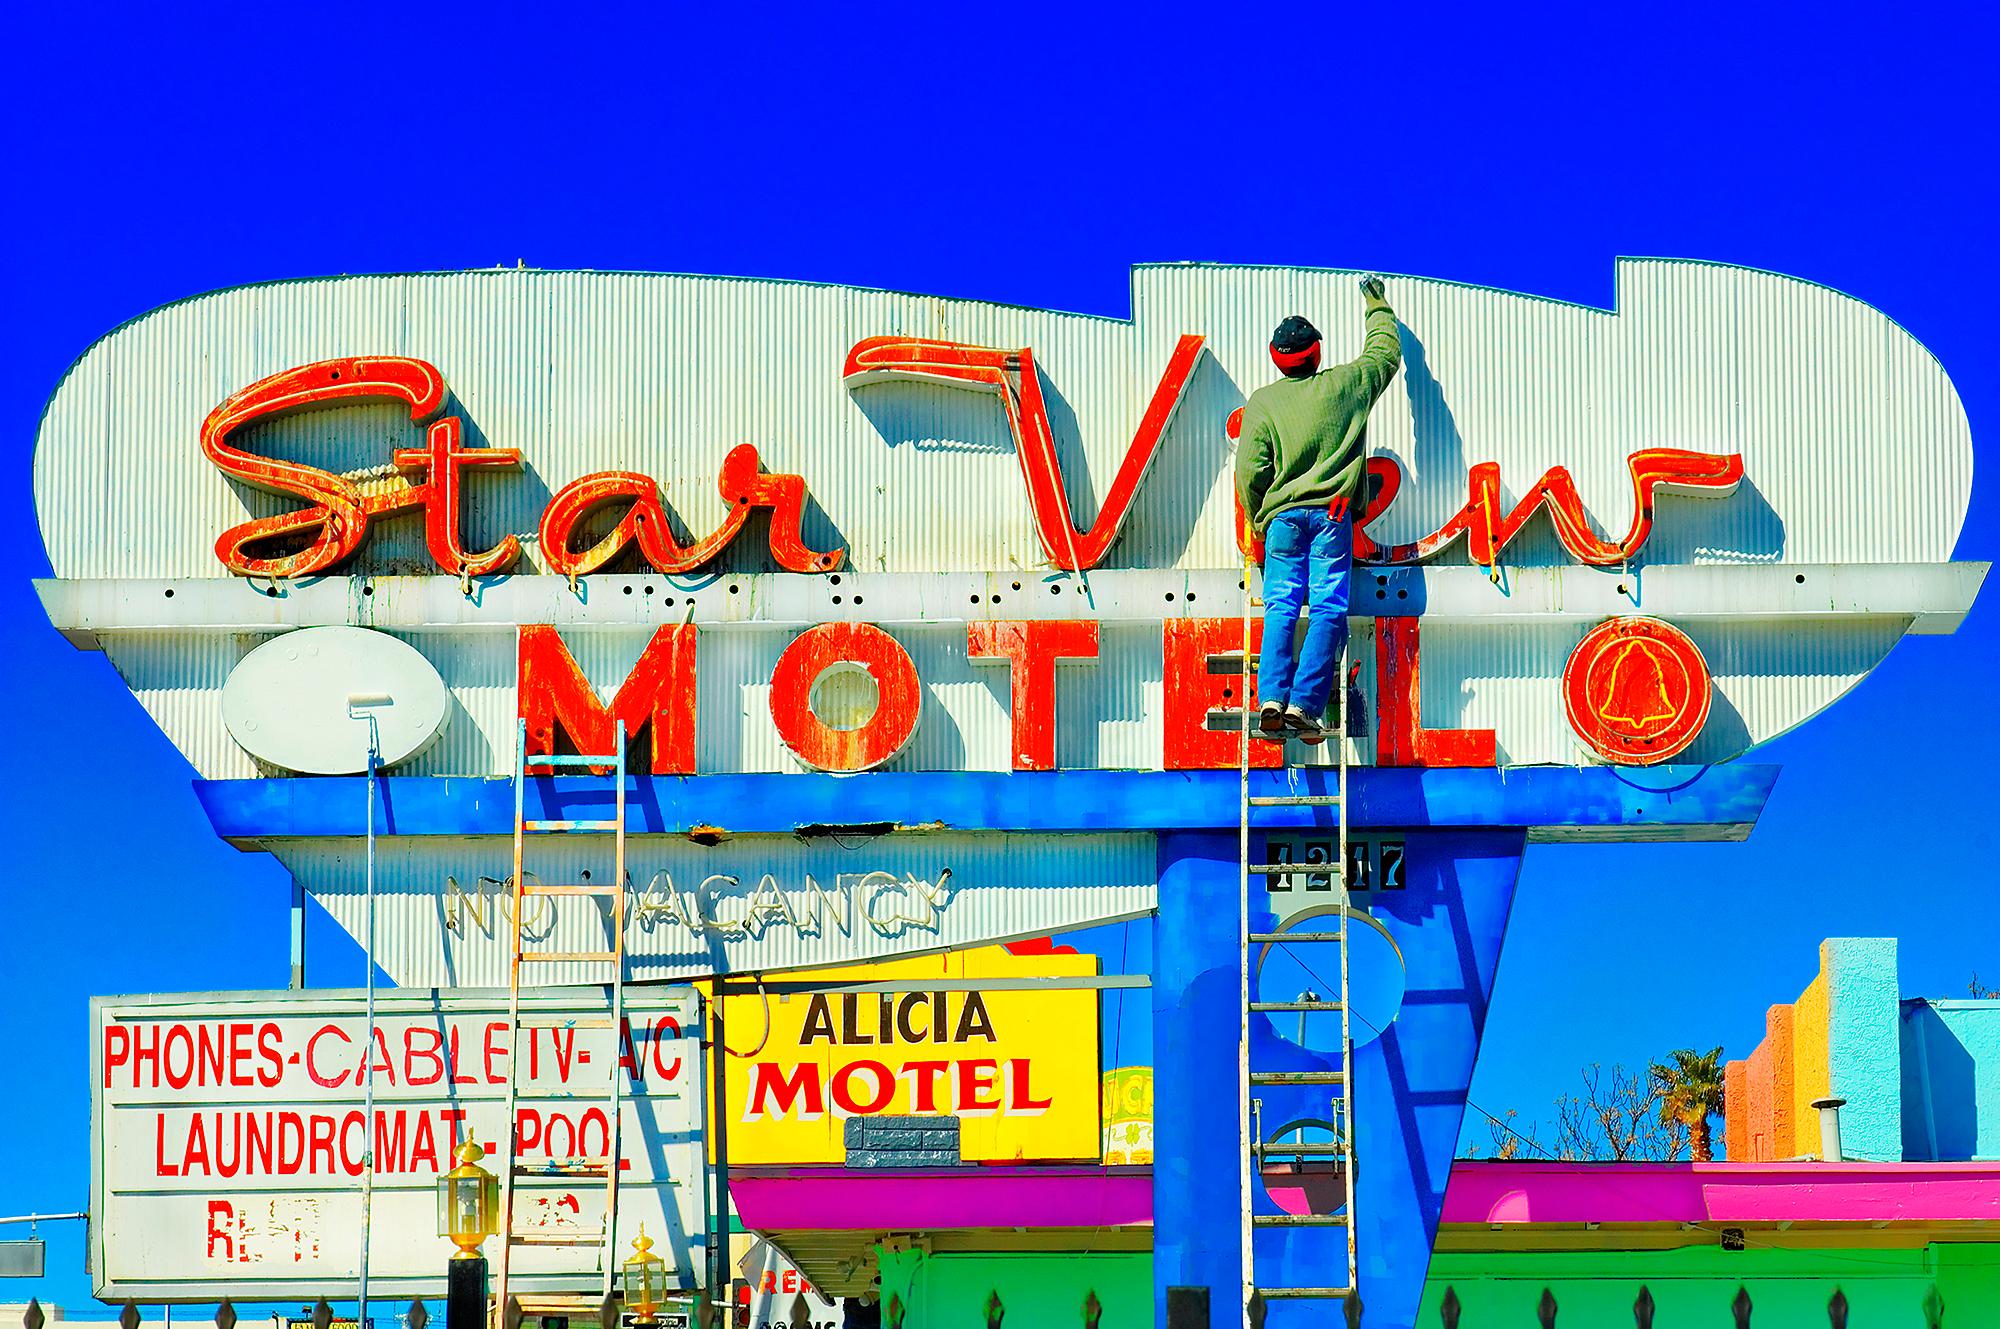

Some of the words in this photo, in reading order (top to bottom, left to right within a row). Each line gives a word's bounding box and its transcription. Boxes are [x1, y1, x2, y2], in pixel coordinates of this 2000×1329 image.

[200, 355, 846, 577] Star
[516, 617, 1497, 776] MOTEL
[1276, 845, 1404, 888] 1217
[445, 870, 545, 928] NO
[799, 992, 997, 1045] ALICIA
[742, 1058, 1053, 1122] MOTEL
